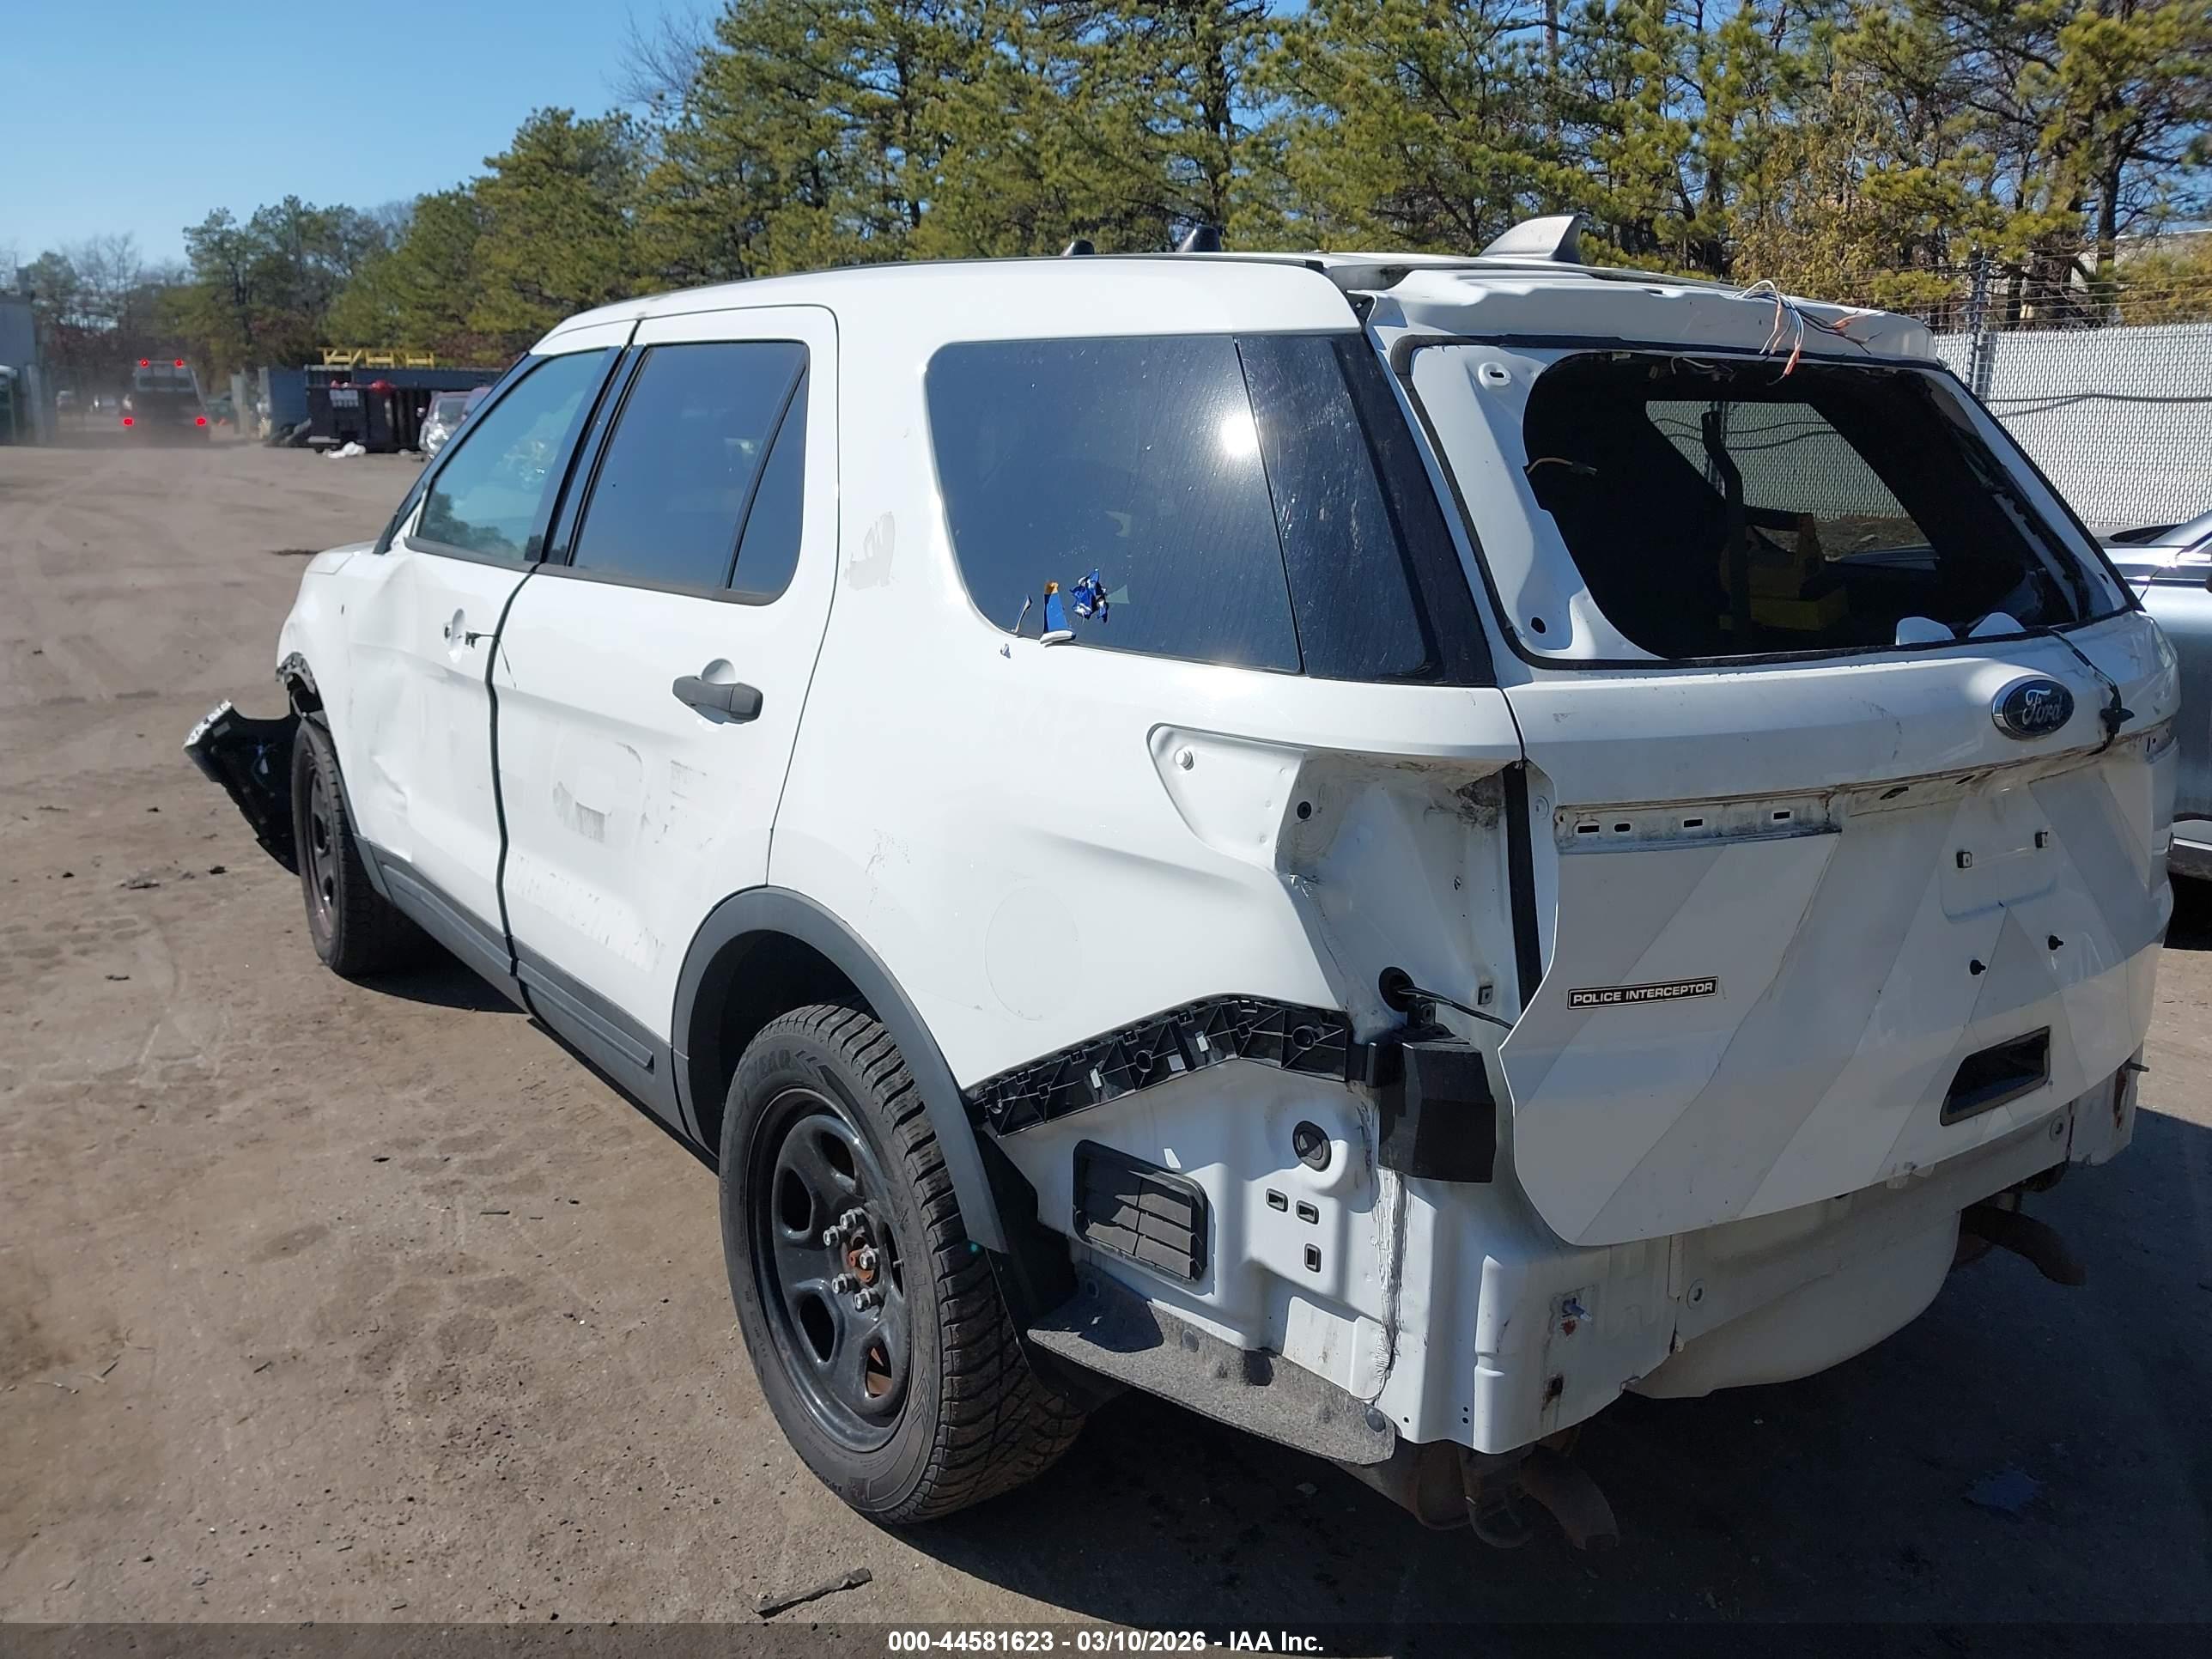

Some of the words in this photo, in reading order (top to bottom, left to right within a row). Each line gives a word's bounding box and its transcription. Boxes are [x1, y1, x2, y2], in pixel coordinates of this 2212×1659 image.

[2022, 689, 2063, 726] Ford
[1573, 992, 1621, 1005] POLICE
[1626, 982, 1713, 1000] INTERCEPTOR
